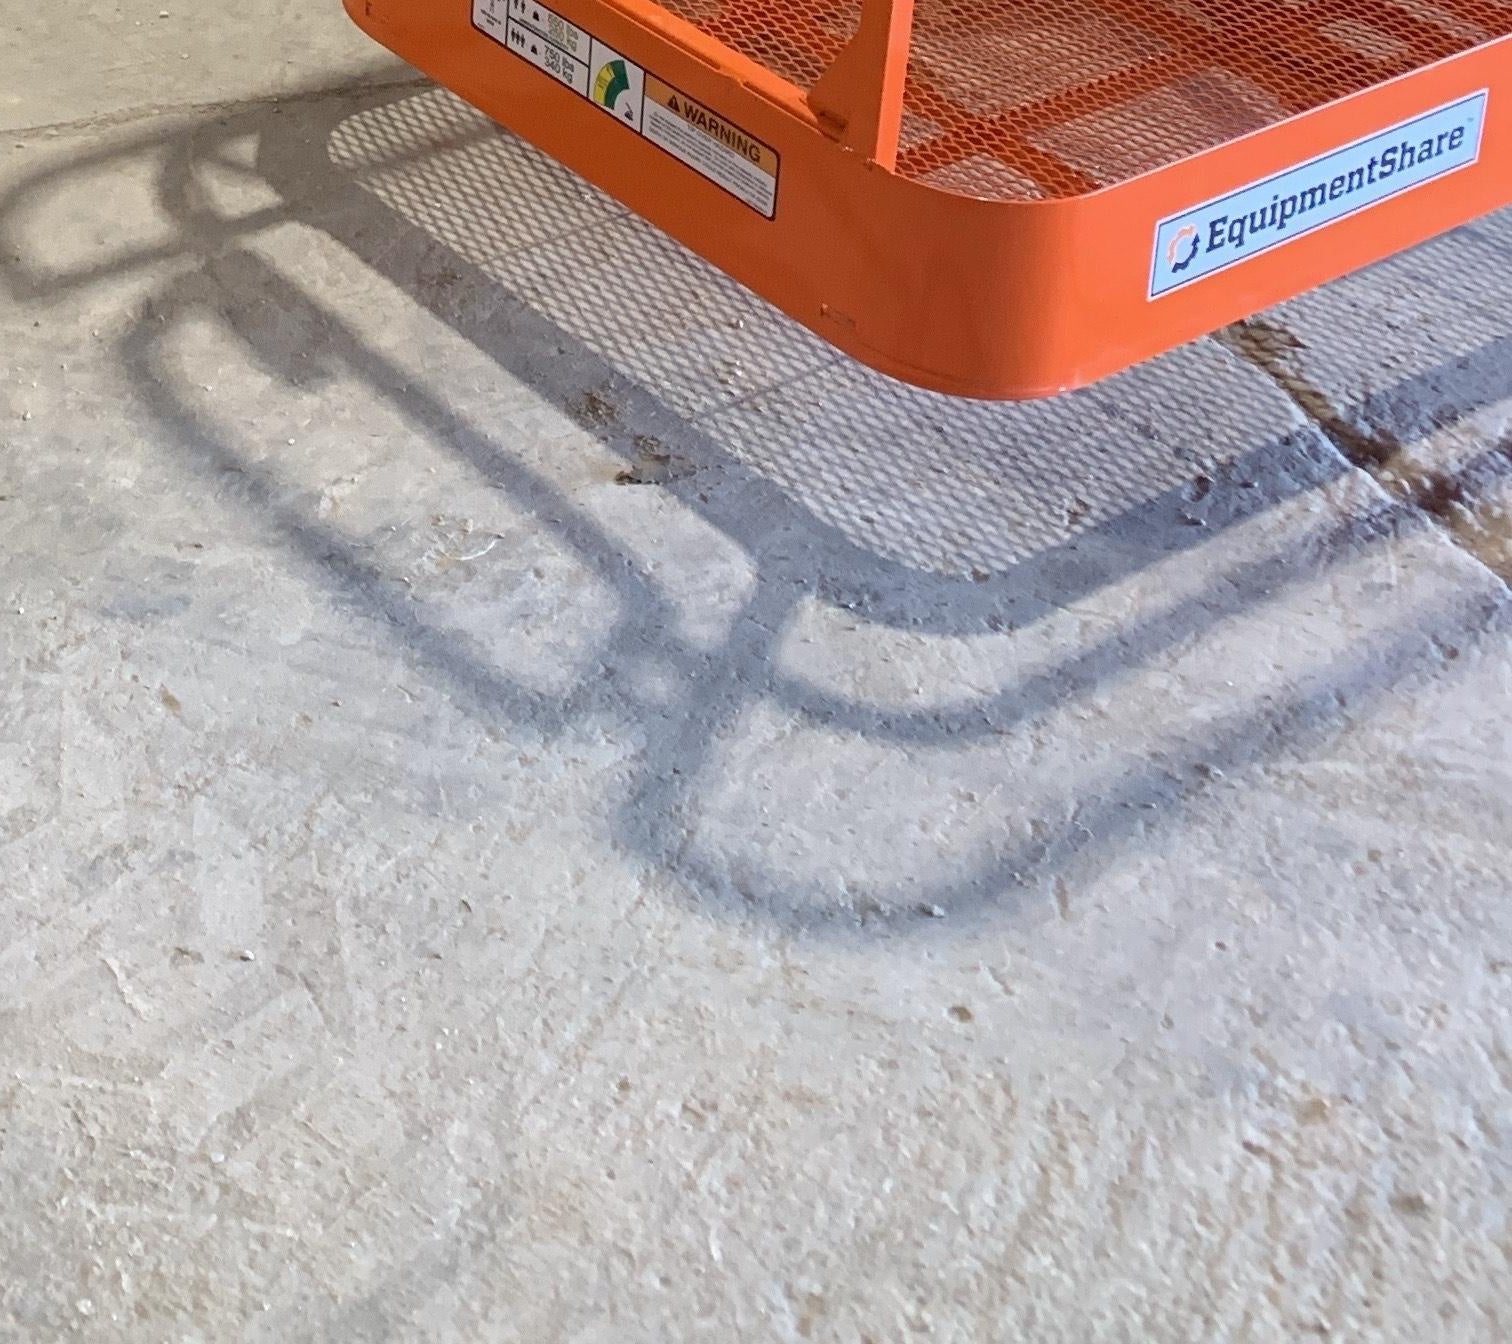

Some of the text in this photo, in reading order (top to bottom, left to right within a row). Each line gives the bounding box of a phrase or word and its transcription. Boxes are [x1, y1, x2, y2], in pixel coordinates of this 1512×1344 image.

[544, 44, 575, 73] 750 lbs
[562, 67, 573, 84] kg
[682, 100, 762, 163] WARNING
[1205, 124, 1466, 254] EquipmentShare
